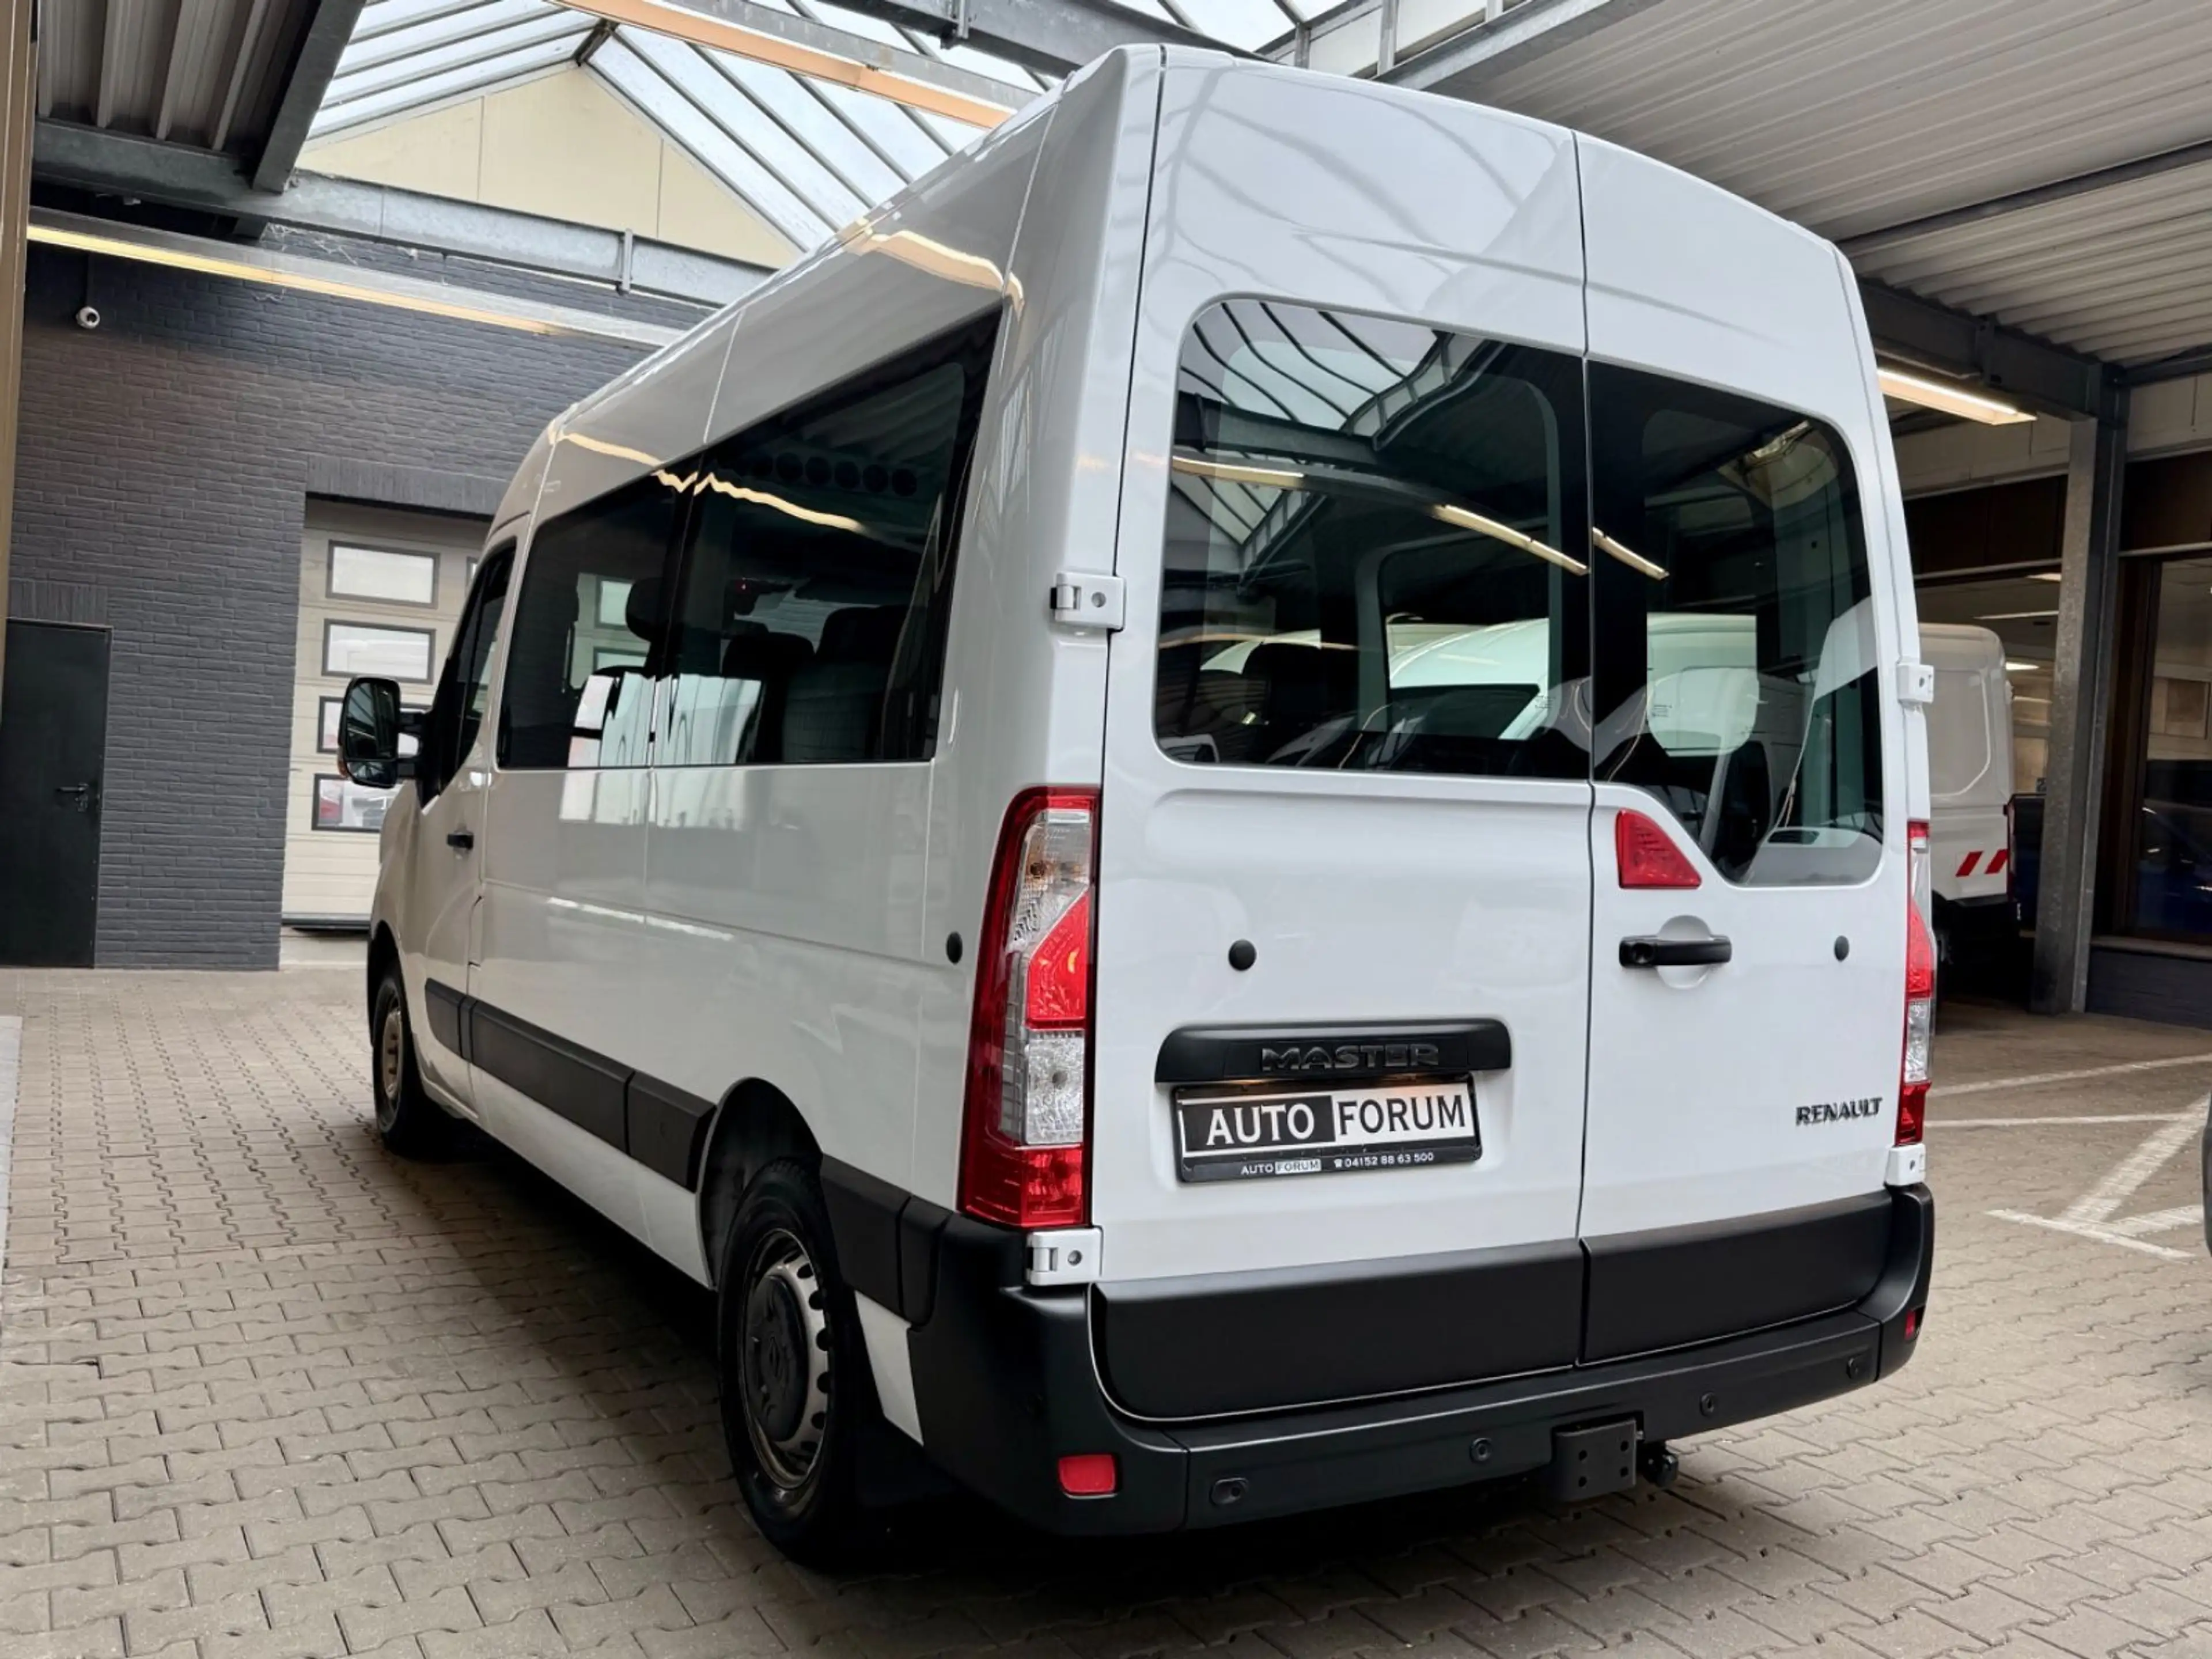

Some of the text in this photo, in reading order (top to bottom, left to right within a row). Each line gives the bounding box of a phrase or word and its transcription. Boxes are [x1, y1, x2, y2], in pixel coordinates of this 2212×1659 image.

[1262, 1044, 1439, 1071] MASTER
[1206, 1095, 1465, 1146] AUTO FORUM
[1796, 1096, 1883, 1126] RENAULT
[1344, 1156, 1378, 1168] 04152
[1414, 1152, 1434, 1162] 500
